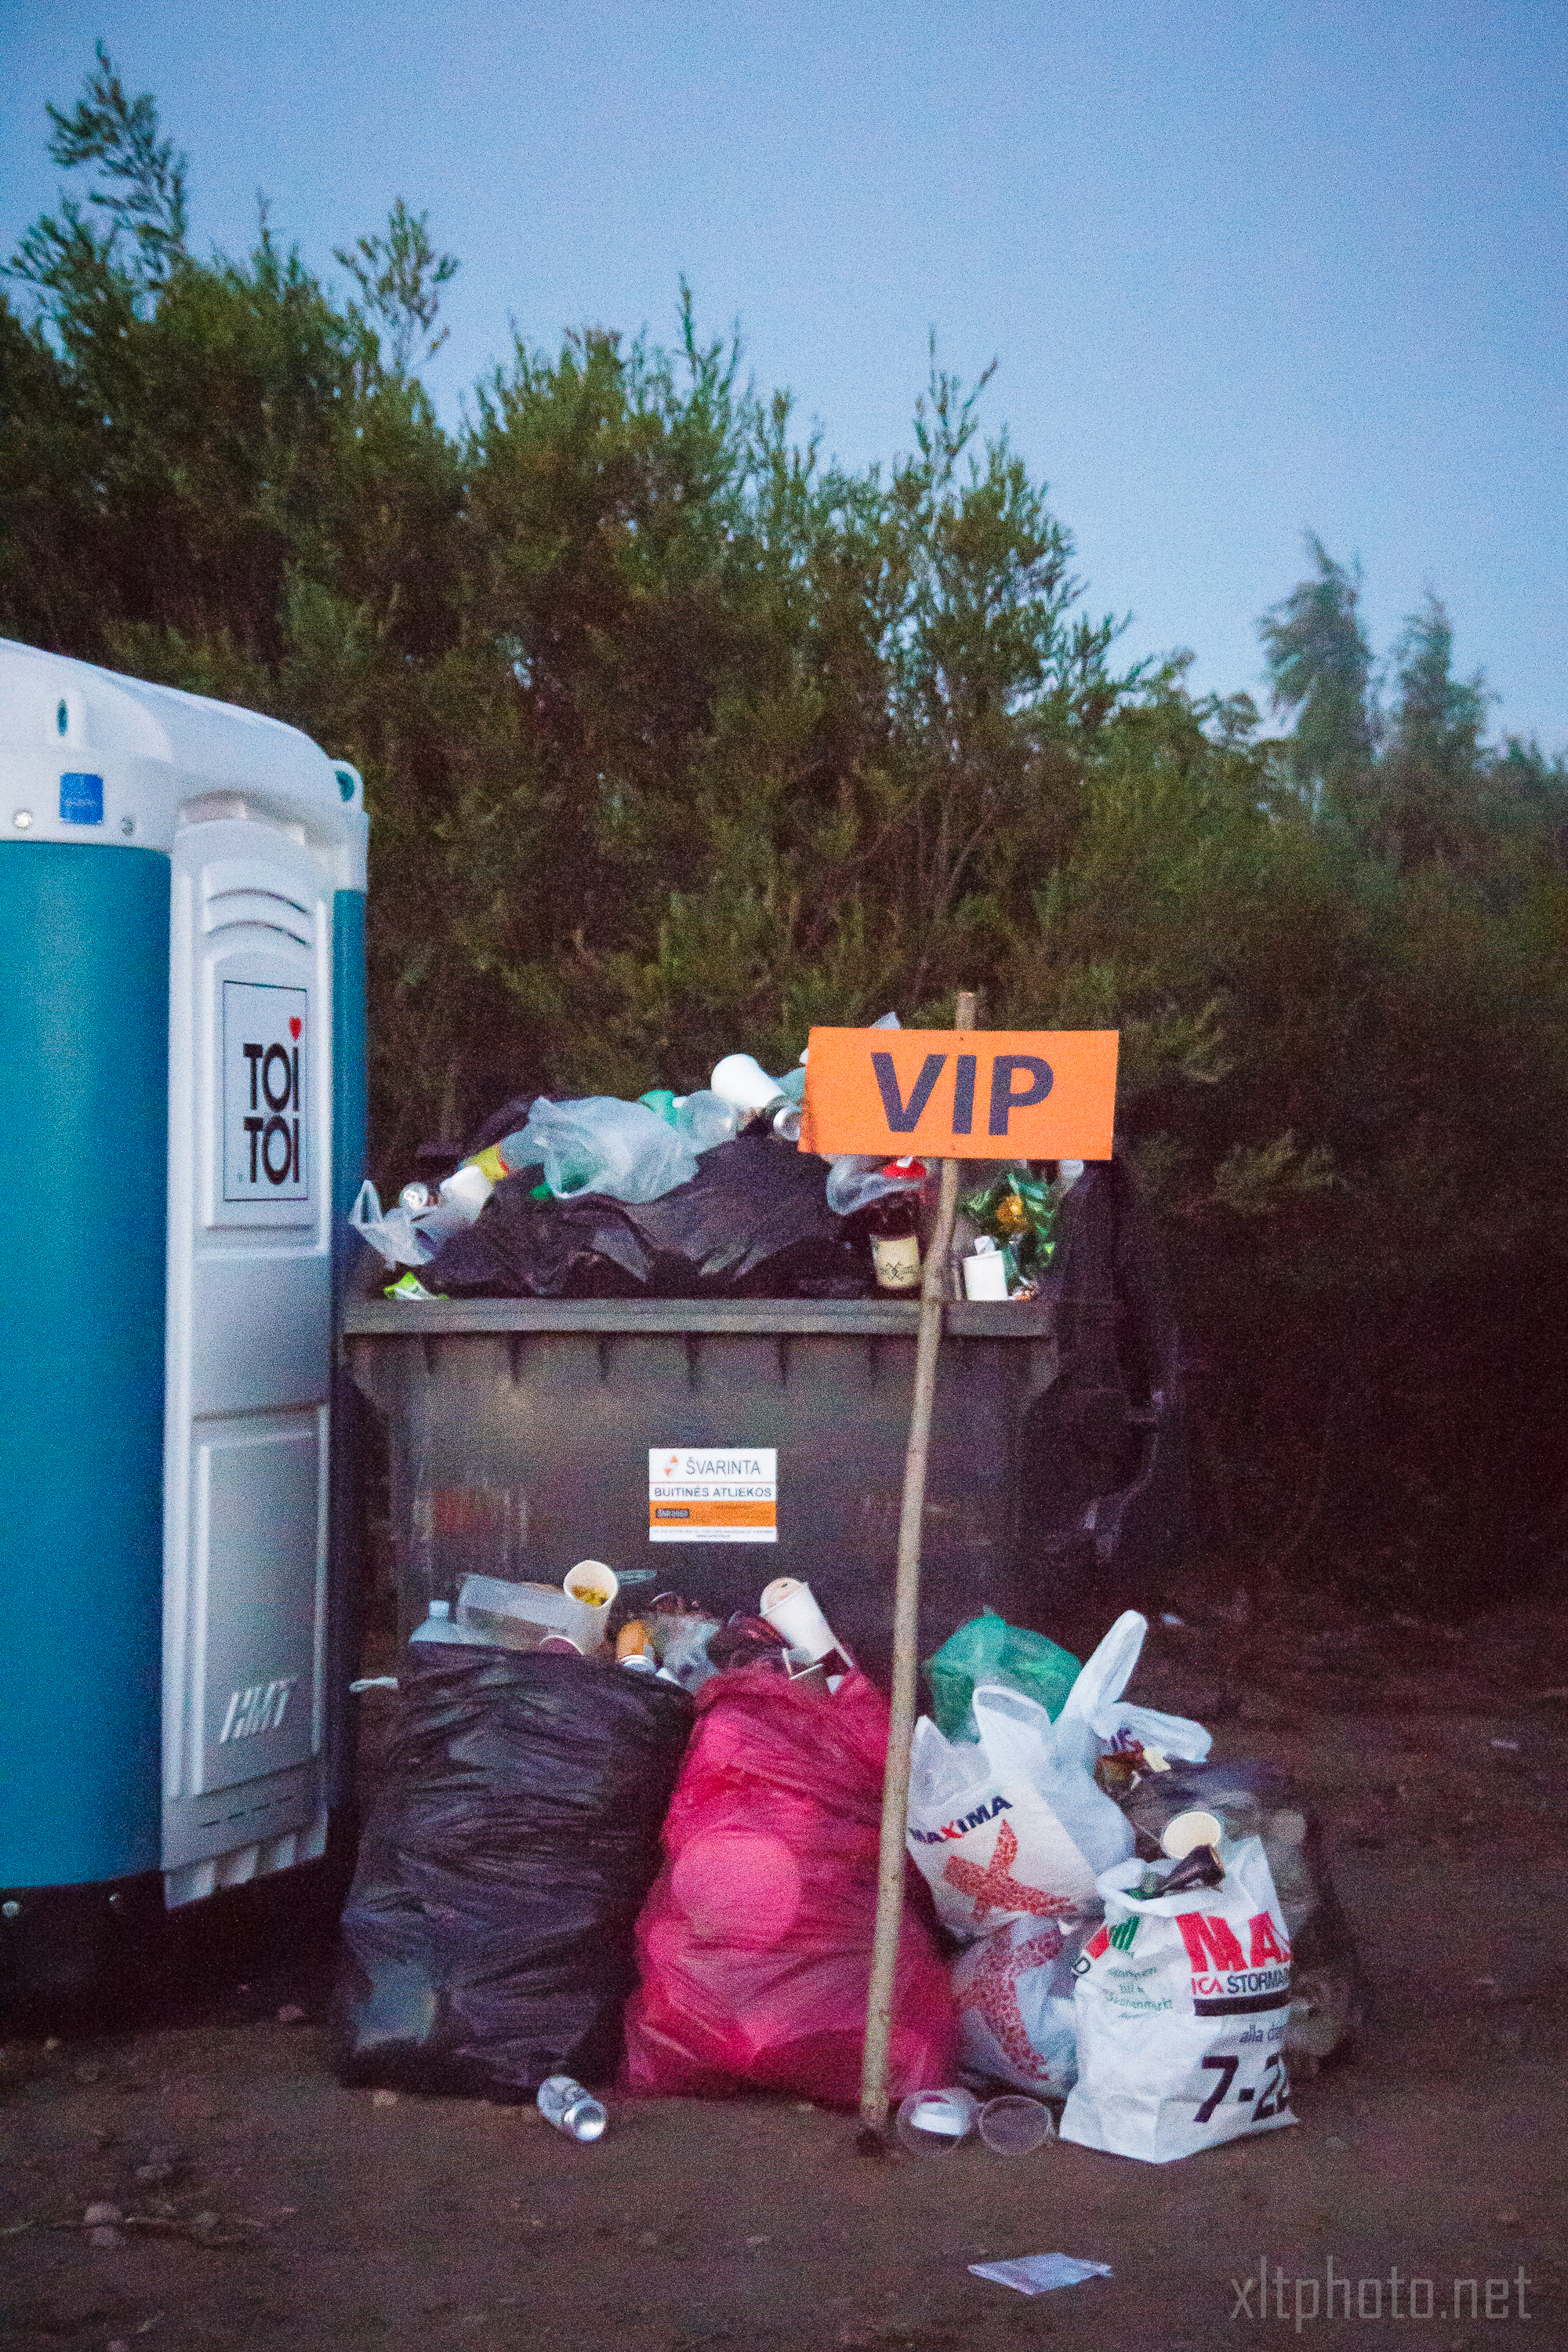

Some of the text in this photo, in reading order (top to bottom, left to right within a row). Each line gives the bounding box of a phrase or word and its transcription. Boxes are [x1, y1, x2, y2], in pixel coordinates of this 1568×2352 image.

[243, 1042, 299, 1112] TOI
[871, 1052, 1054, 1136] VIP
[243, 1115, 299, 1185] TOI
[686, 1457, 760, 1475] ŠVARINTA
[654, 1486, 772, 1497] BUITINĖS ATLIEKOS
[1190, 1966, 1288, 1994] ICA STORMA
